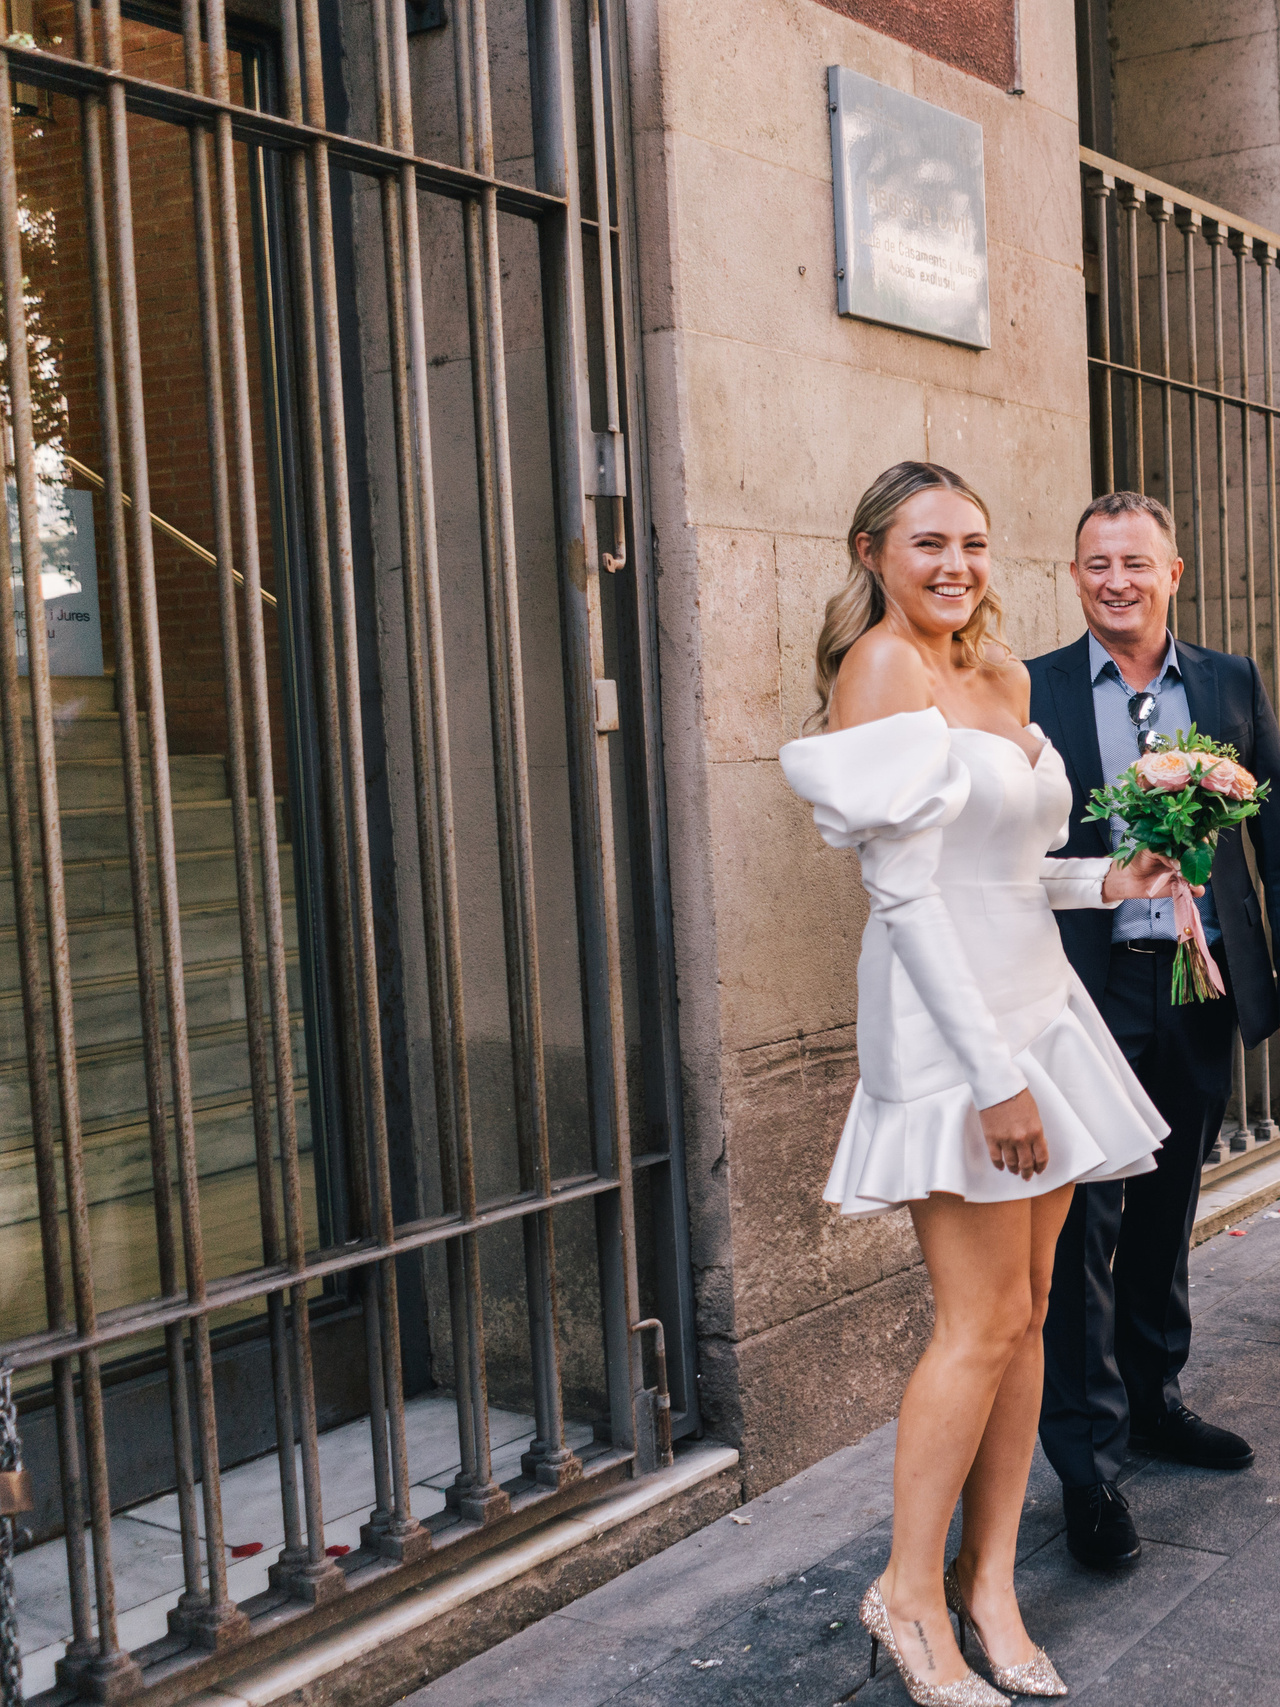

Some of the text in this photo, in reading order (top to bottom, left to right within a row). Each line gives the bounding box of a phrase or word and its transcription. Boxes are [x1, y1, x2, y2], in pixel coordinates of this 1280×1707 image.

[884, 236, 895, 253] de
[899, 241, 947, 270] Casaments
[955, 260, 977, 279] Jures
[57, 609, 91, 621] Jures
